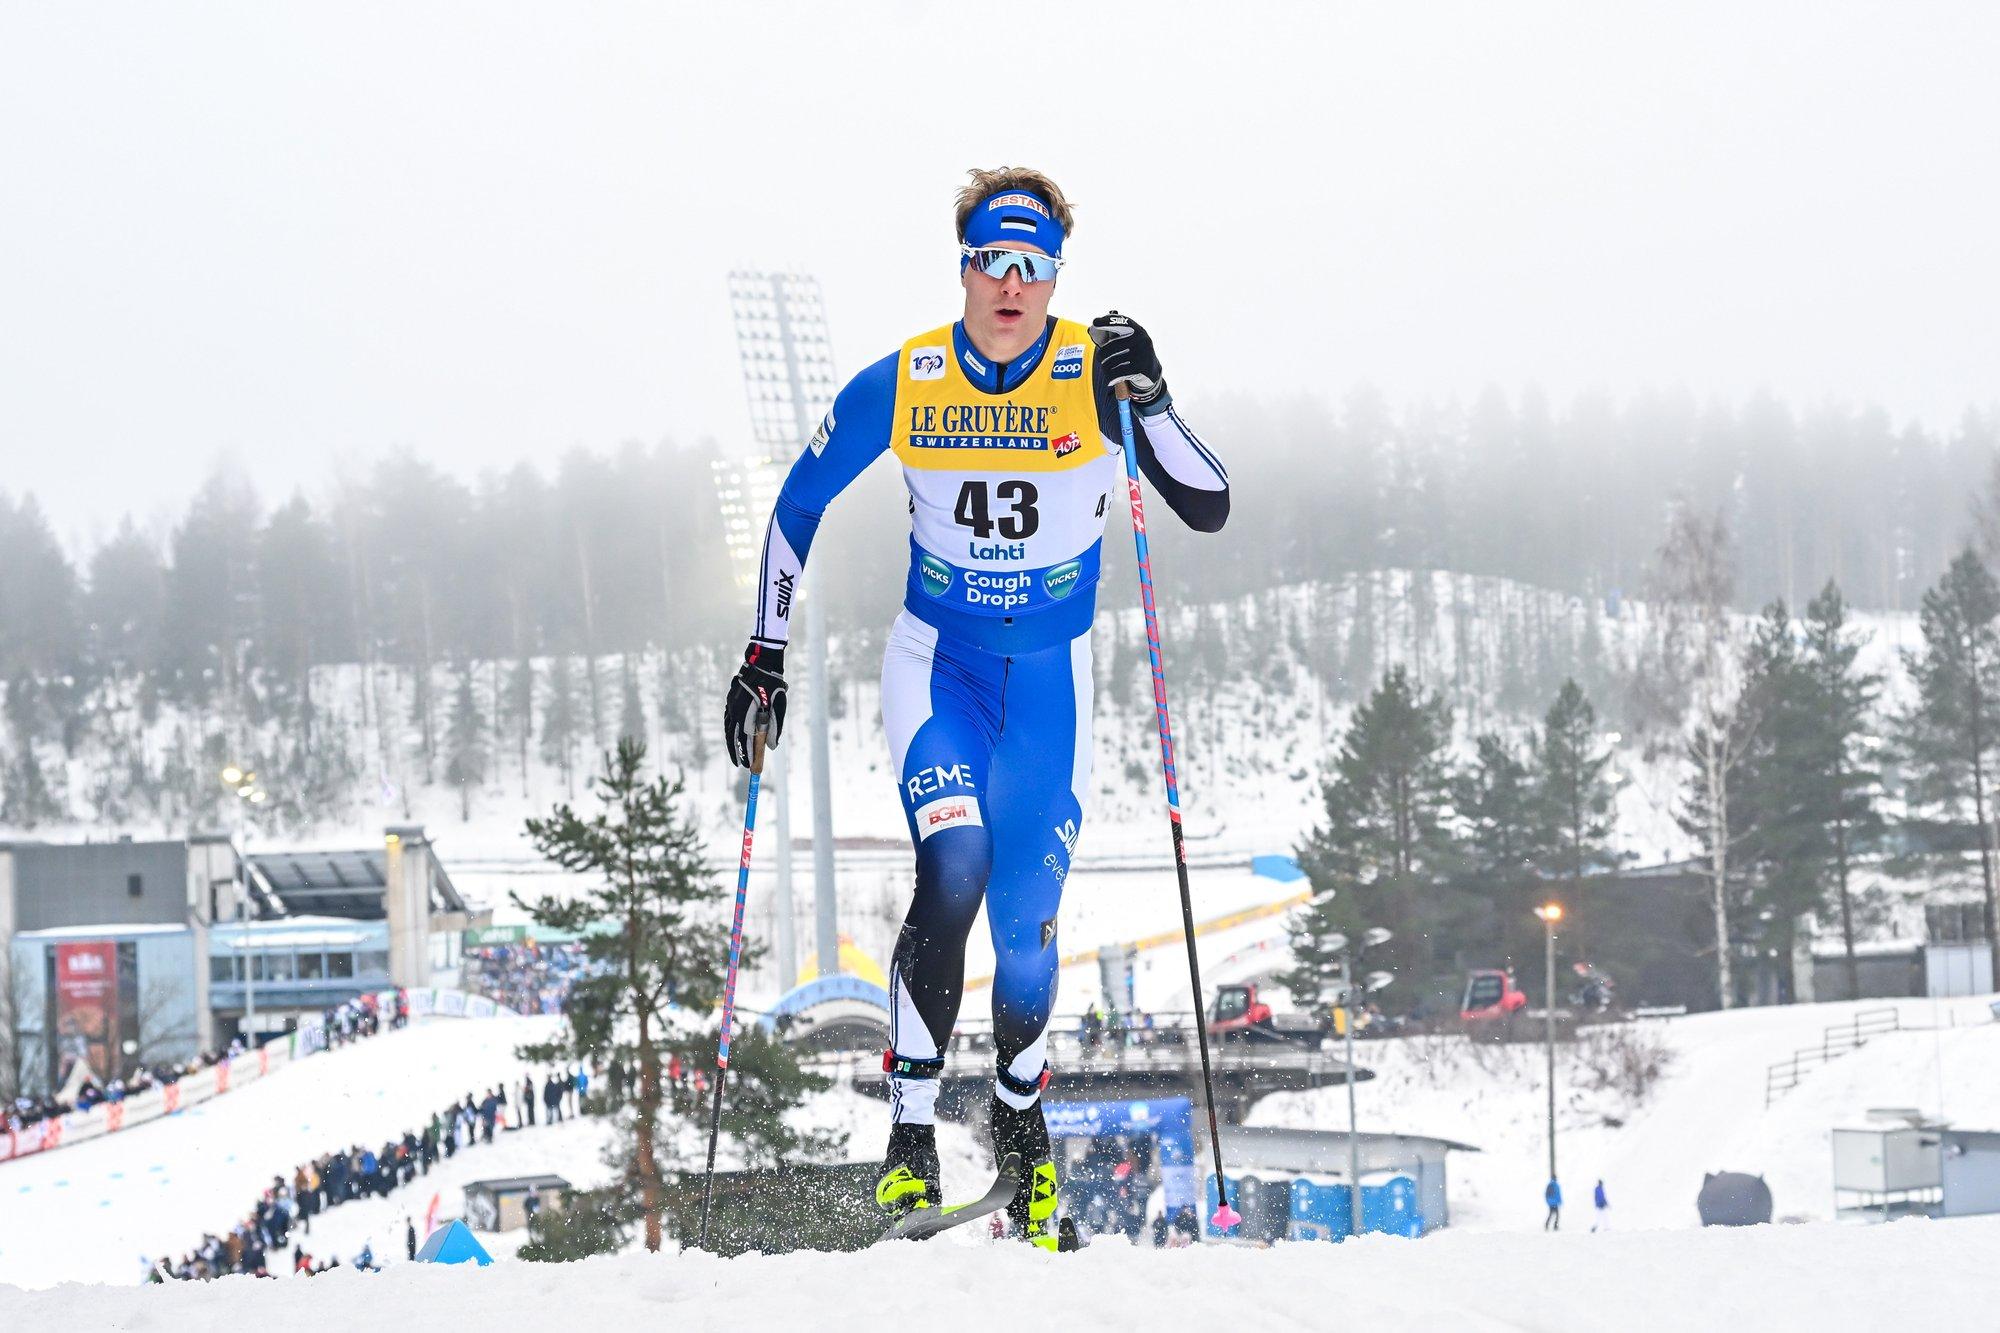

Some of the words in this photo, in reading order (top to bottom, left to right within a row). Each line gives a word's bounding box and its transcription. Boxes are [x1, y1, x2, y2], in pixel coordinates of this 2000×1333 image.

[990, 196, 1049, 217] RESTATE
[1053, 363, 1081, 373] coop
[911, 406, 937, 432] LE
[915, 436, 1042, 448] SWITZERLAND
[1056, 438, 1080, 454] AOP
[953, 480, 1040, 540] 43
[922, 564, 950, 585] VICKS
[963, 571, 1032, 593] Cough
[1046, 568, 1079, 588] VICKS
[966, 588, 1029, 610] Drops
[907, 764, 975, 803] REME
